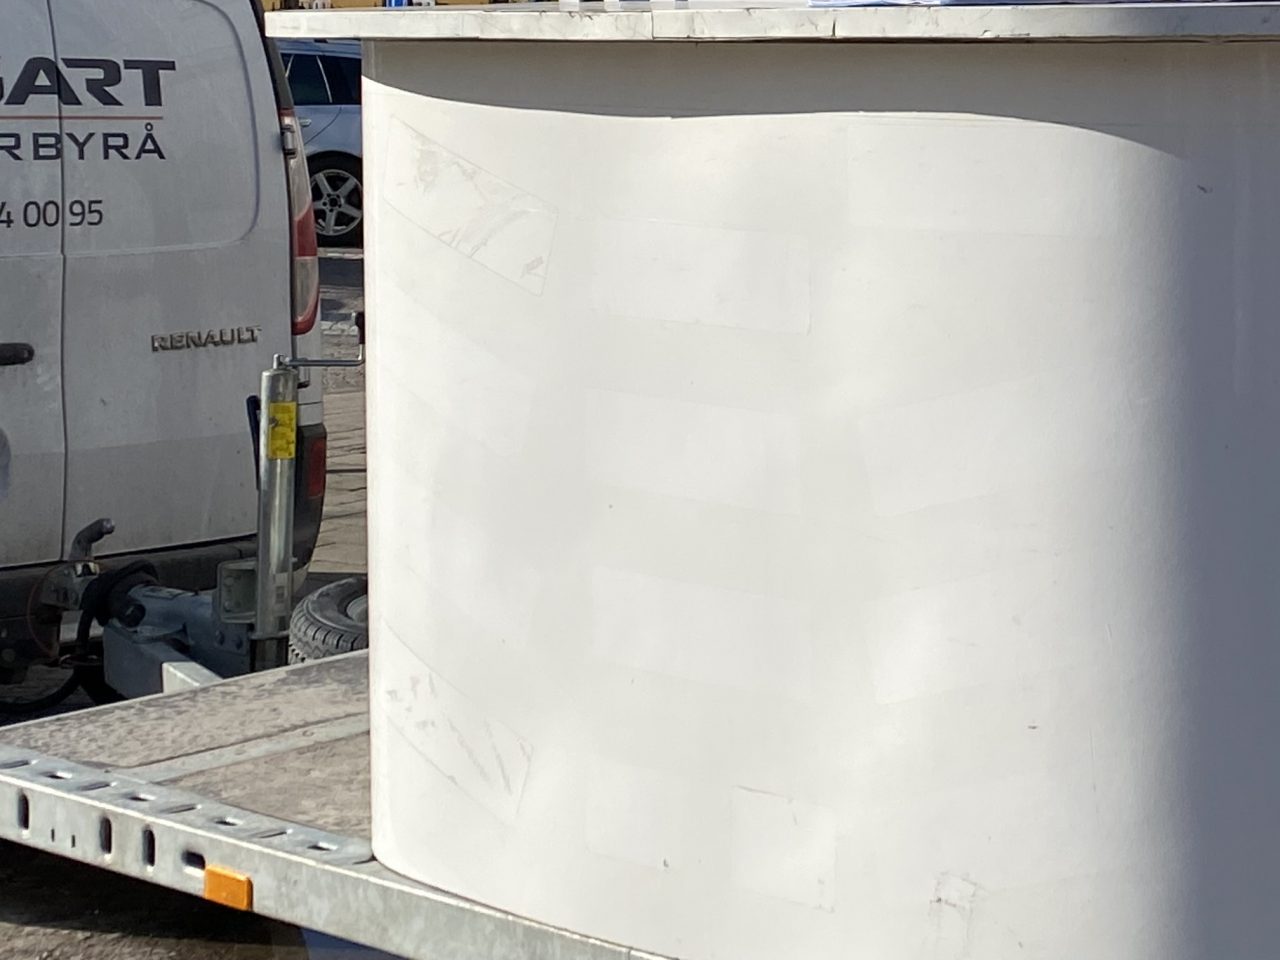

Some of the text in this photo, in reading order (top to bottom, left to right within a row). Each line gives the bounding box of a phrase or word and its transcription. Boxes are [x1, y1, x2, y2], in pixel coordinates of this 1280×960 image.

[0, 56, 176, 107] ART
[23, 200, 60, 228] 00
[68, 200, 103, 227] 95
[151, 324, 262, 352] RENAULT
